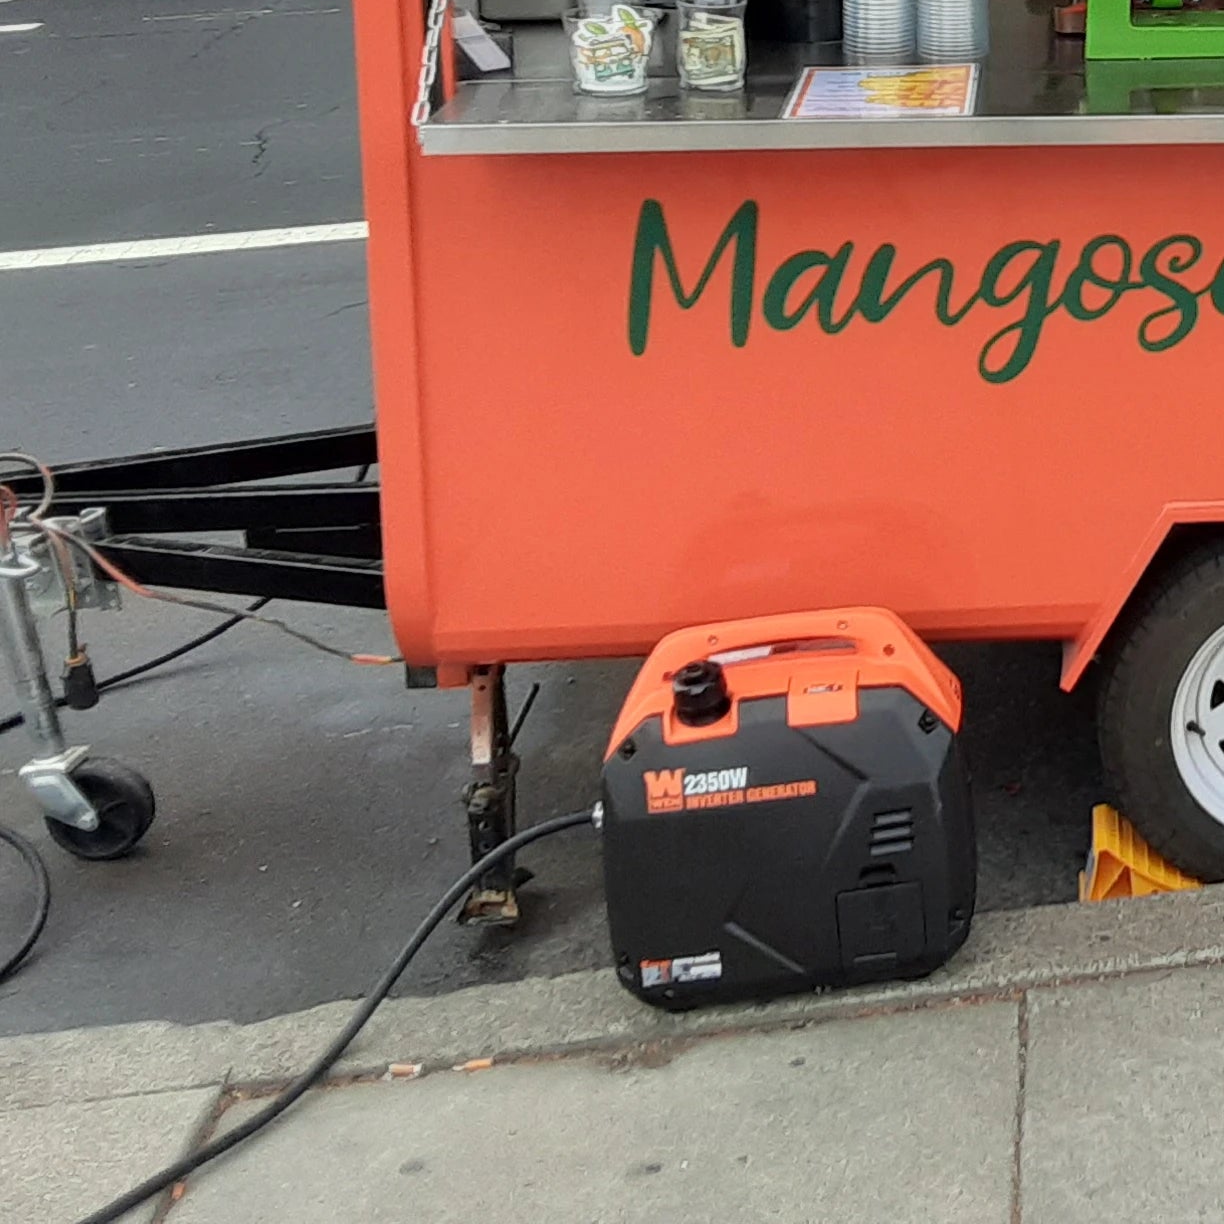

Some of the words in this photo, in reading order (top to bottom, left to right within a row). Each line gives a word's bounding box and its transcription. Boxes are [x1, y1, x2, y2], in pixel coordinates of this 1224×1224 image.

[684, 767, 748, 795] 2350W
[686, 790, 744, 810] INVERTER
[746, 780, 817, 803] GENERATOR
